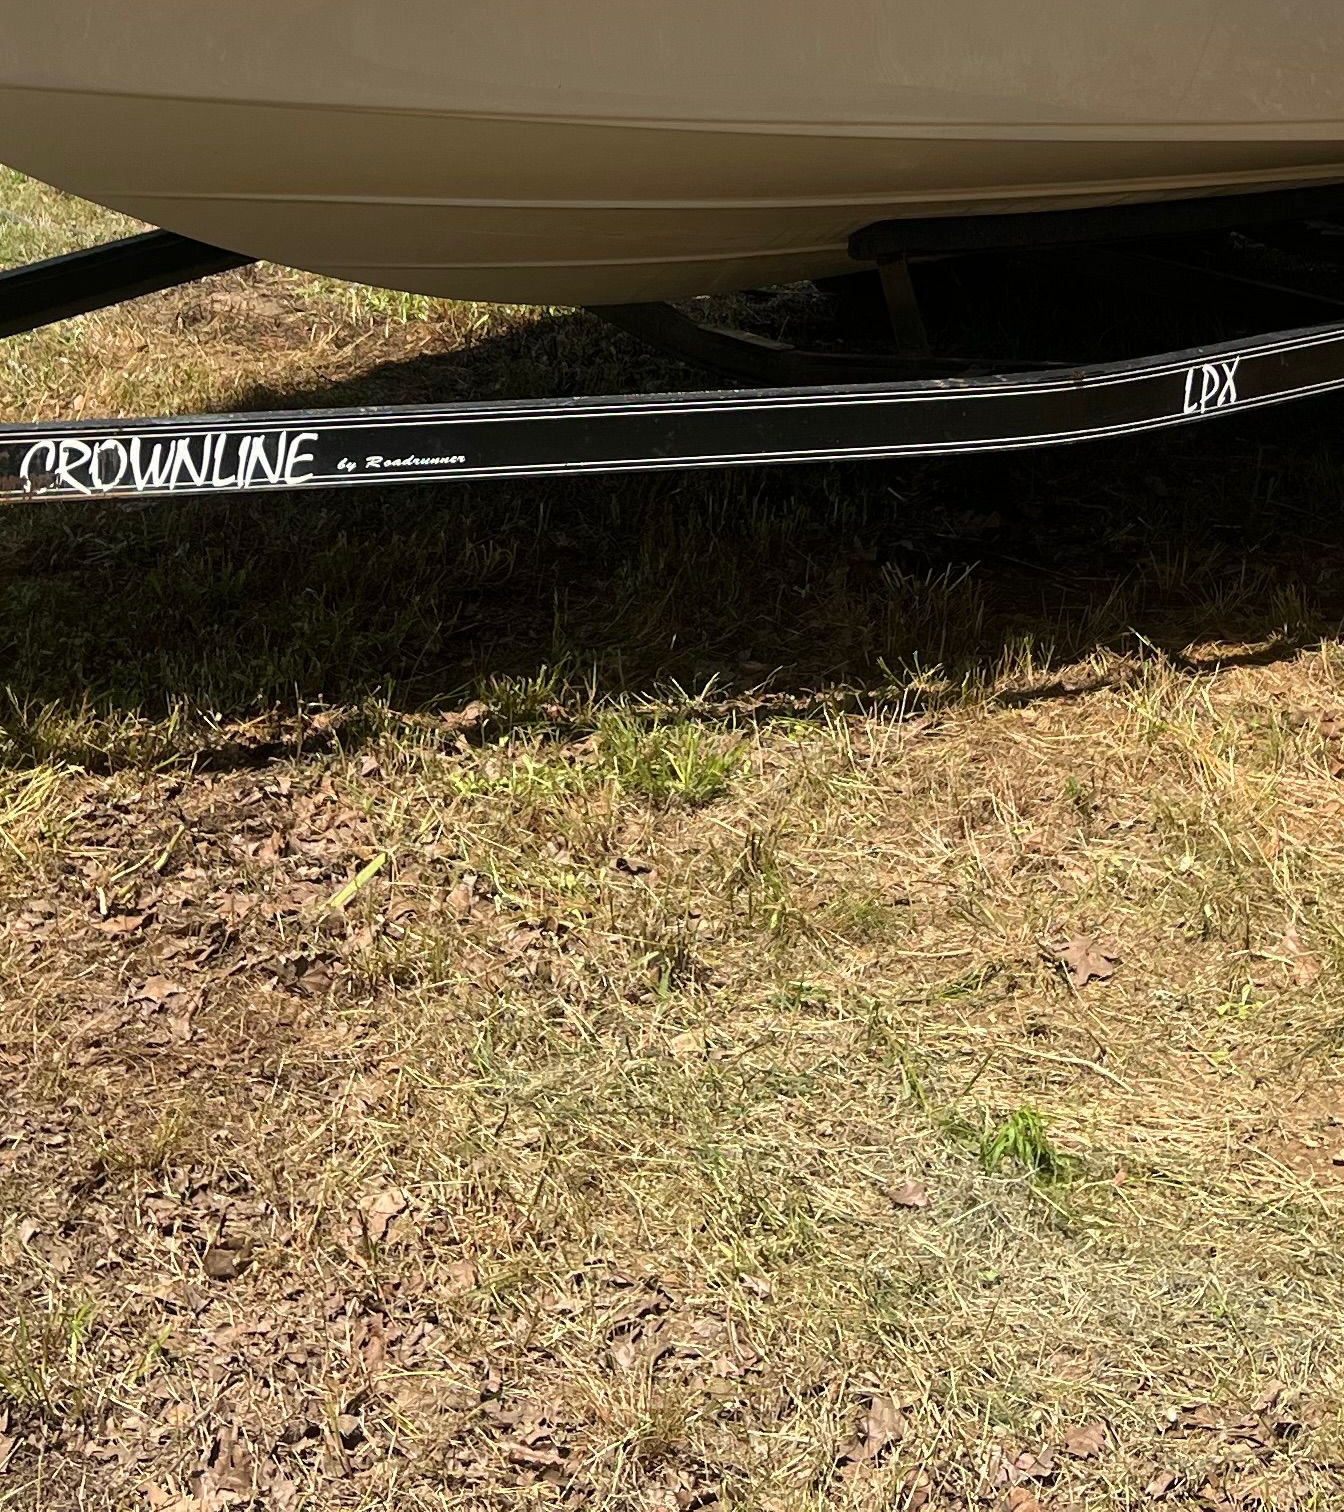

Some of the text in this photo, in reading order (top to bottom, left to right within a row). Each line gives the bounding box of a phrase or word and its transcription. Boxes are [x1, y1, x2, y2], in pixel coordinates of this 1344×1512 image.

[1183, 355, 1240, 414] LPX
[20, 430, 467, 496] CROWNLINE by Roadrunner
